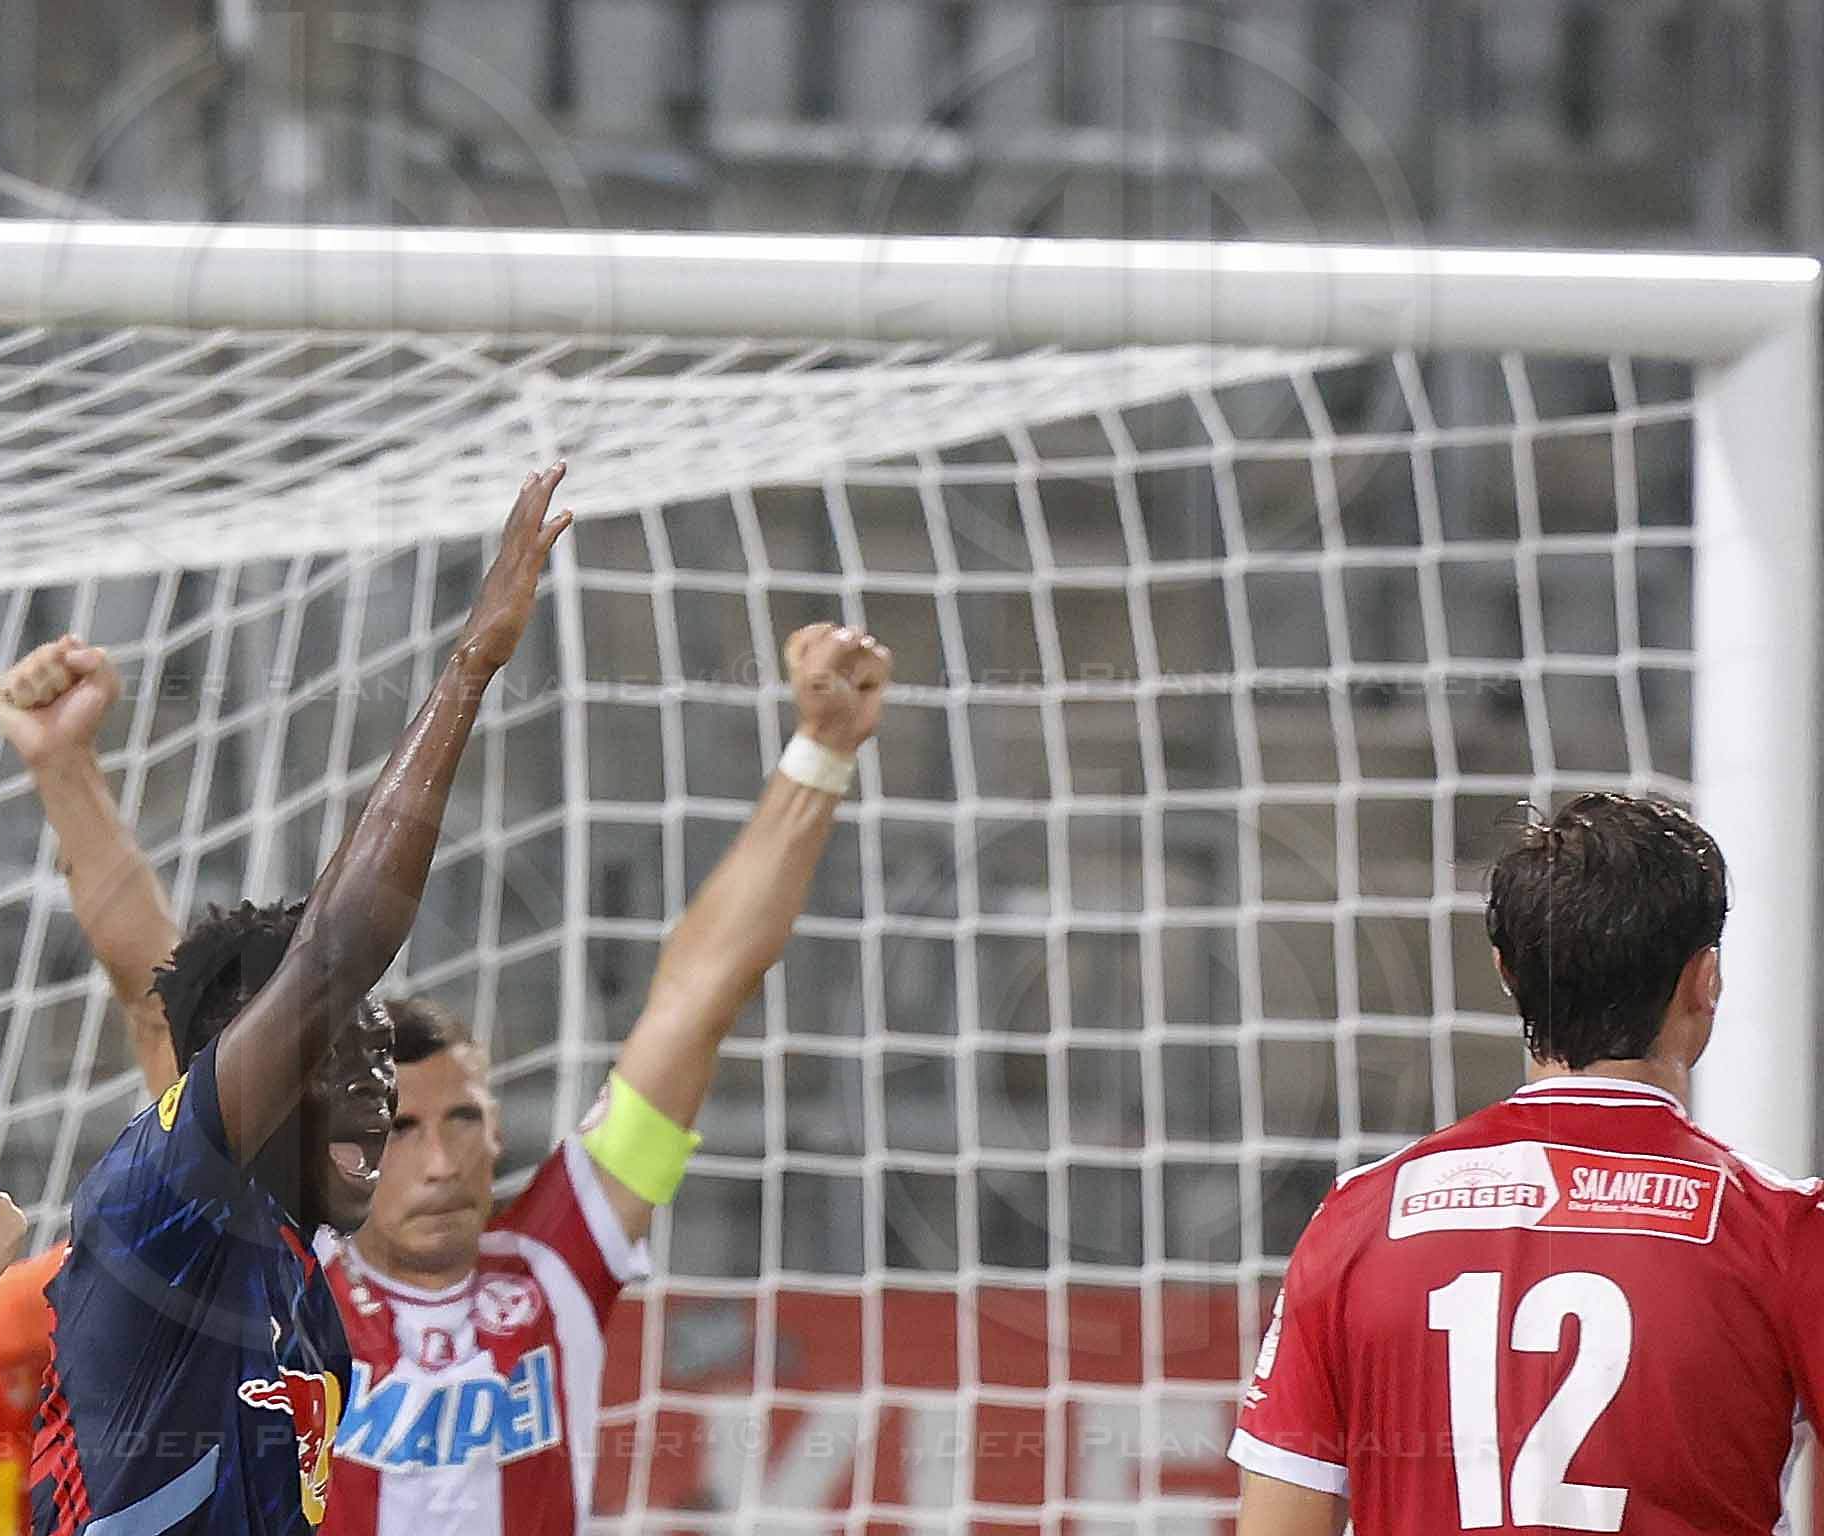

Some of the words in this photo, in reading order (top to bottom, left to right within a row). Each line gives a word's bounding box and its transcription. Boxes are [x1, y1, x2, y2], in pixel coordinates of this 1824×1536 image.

[1407, 1185, 1538, 1216] SORGER
[1569, 1167, 1701, 1211] SALANETTIS
[336, 1350, 555, 1466] MAPEI
[1428, 1271, 1633, 1534] 12
